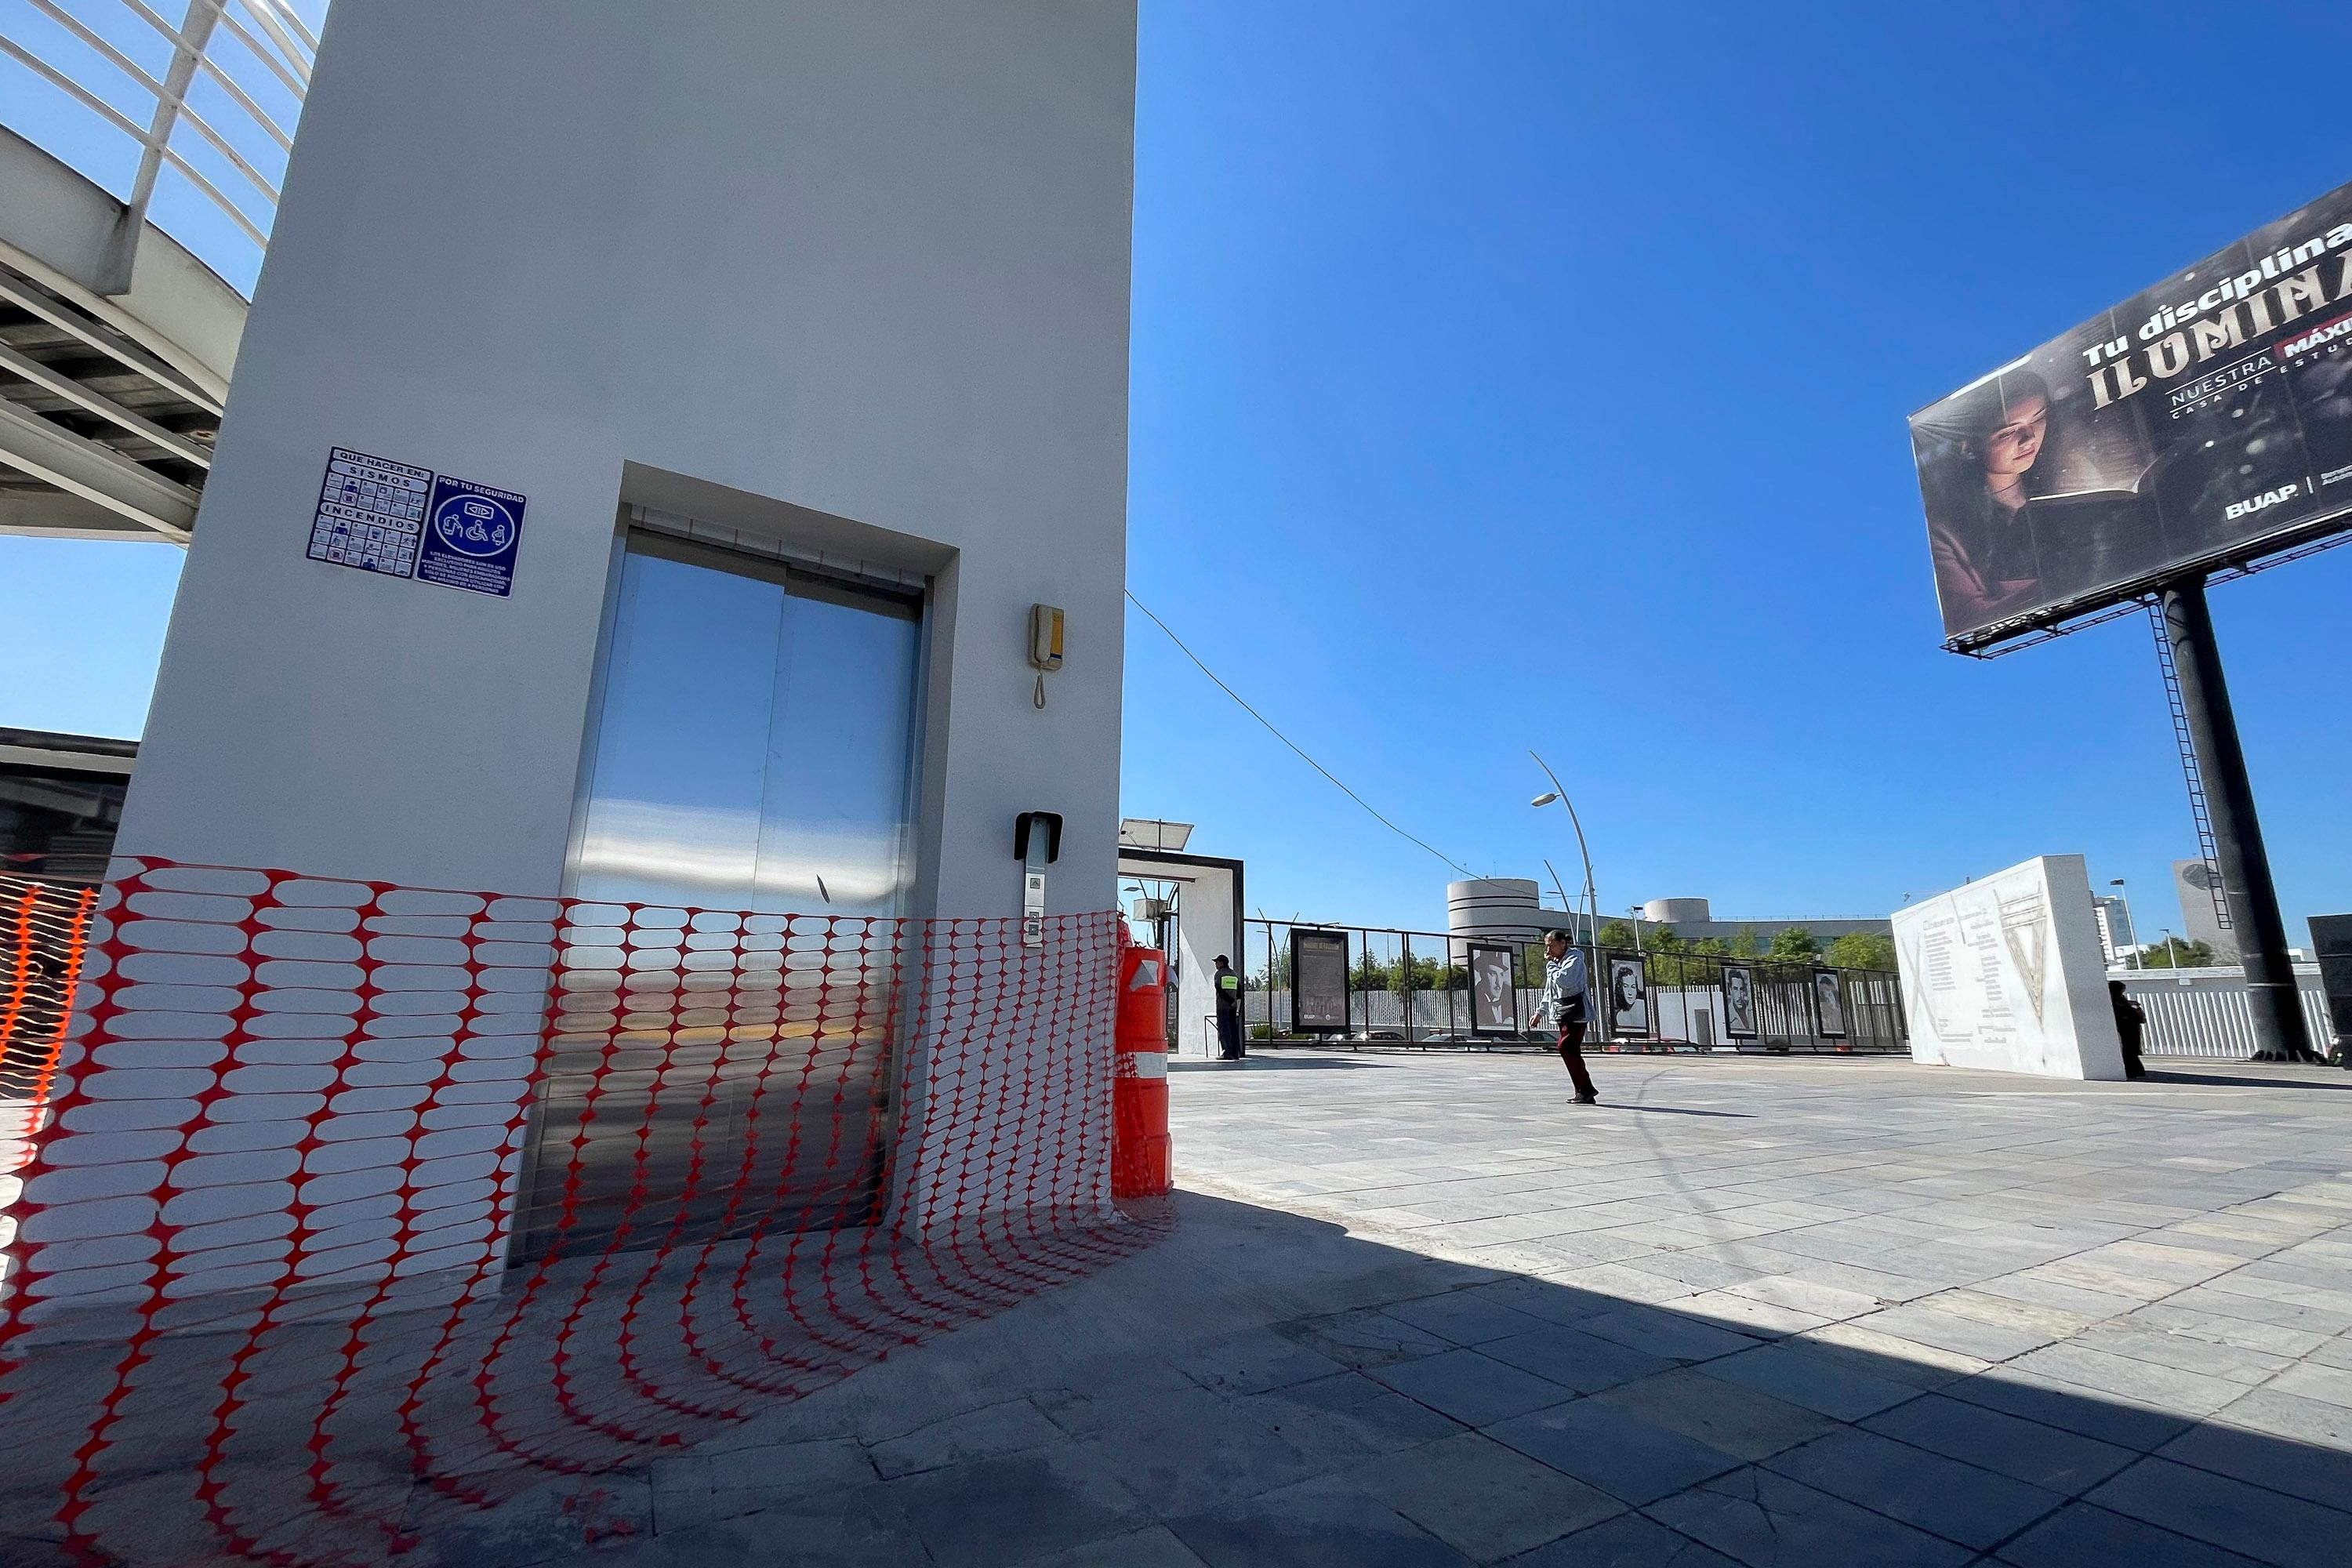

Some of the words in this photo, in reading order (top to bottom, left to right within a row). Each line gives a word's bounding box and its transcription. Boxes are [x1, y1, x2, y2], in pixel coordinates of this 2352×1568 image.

[2082, 336, 2129, 366] Tu
[2138, 223, 2352, 340] disciplina
[2171, 356, 2272, 406] NUESTRA
[2172, 394, 2223, 419] CASA
[2238, 376, 2263, 391] DE
[340, 452, 363, 463] QUE
[367, 459, 403, 473] HACER
[407, 468, 424, 478] EN:
[350, 466, 410, 487] SISMOS
[439, 477, 458, 487] POR
[474, 485, 524, 503] SEGURIDAD
[2225, 484, 2297, 521] BUAP
[325, 505, 415, 531] INCENDIOS
[441, 554, 475, 564] ELEVADORES
